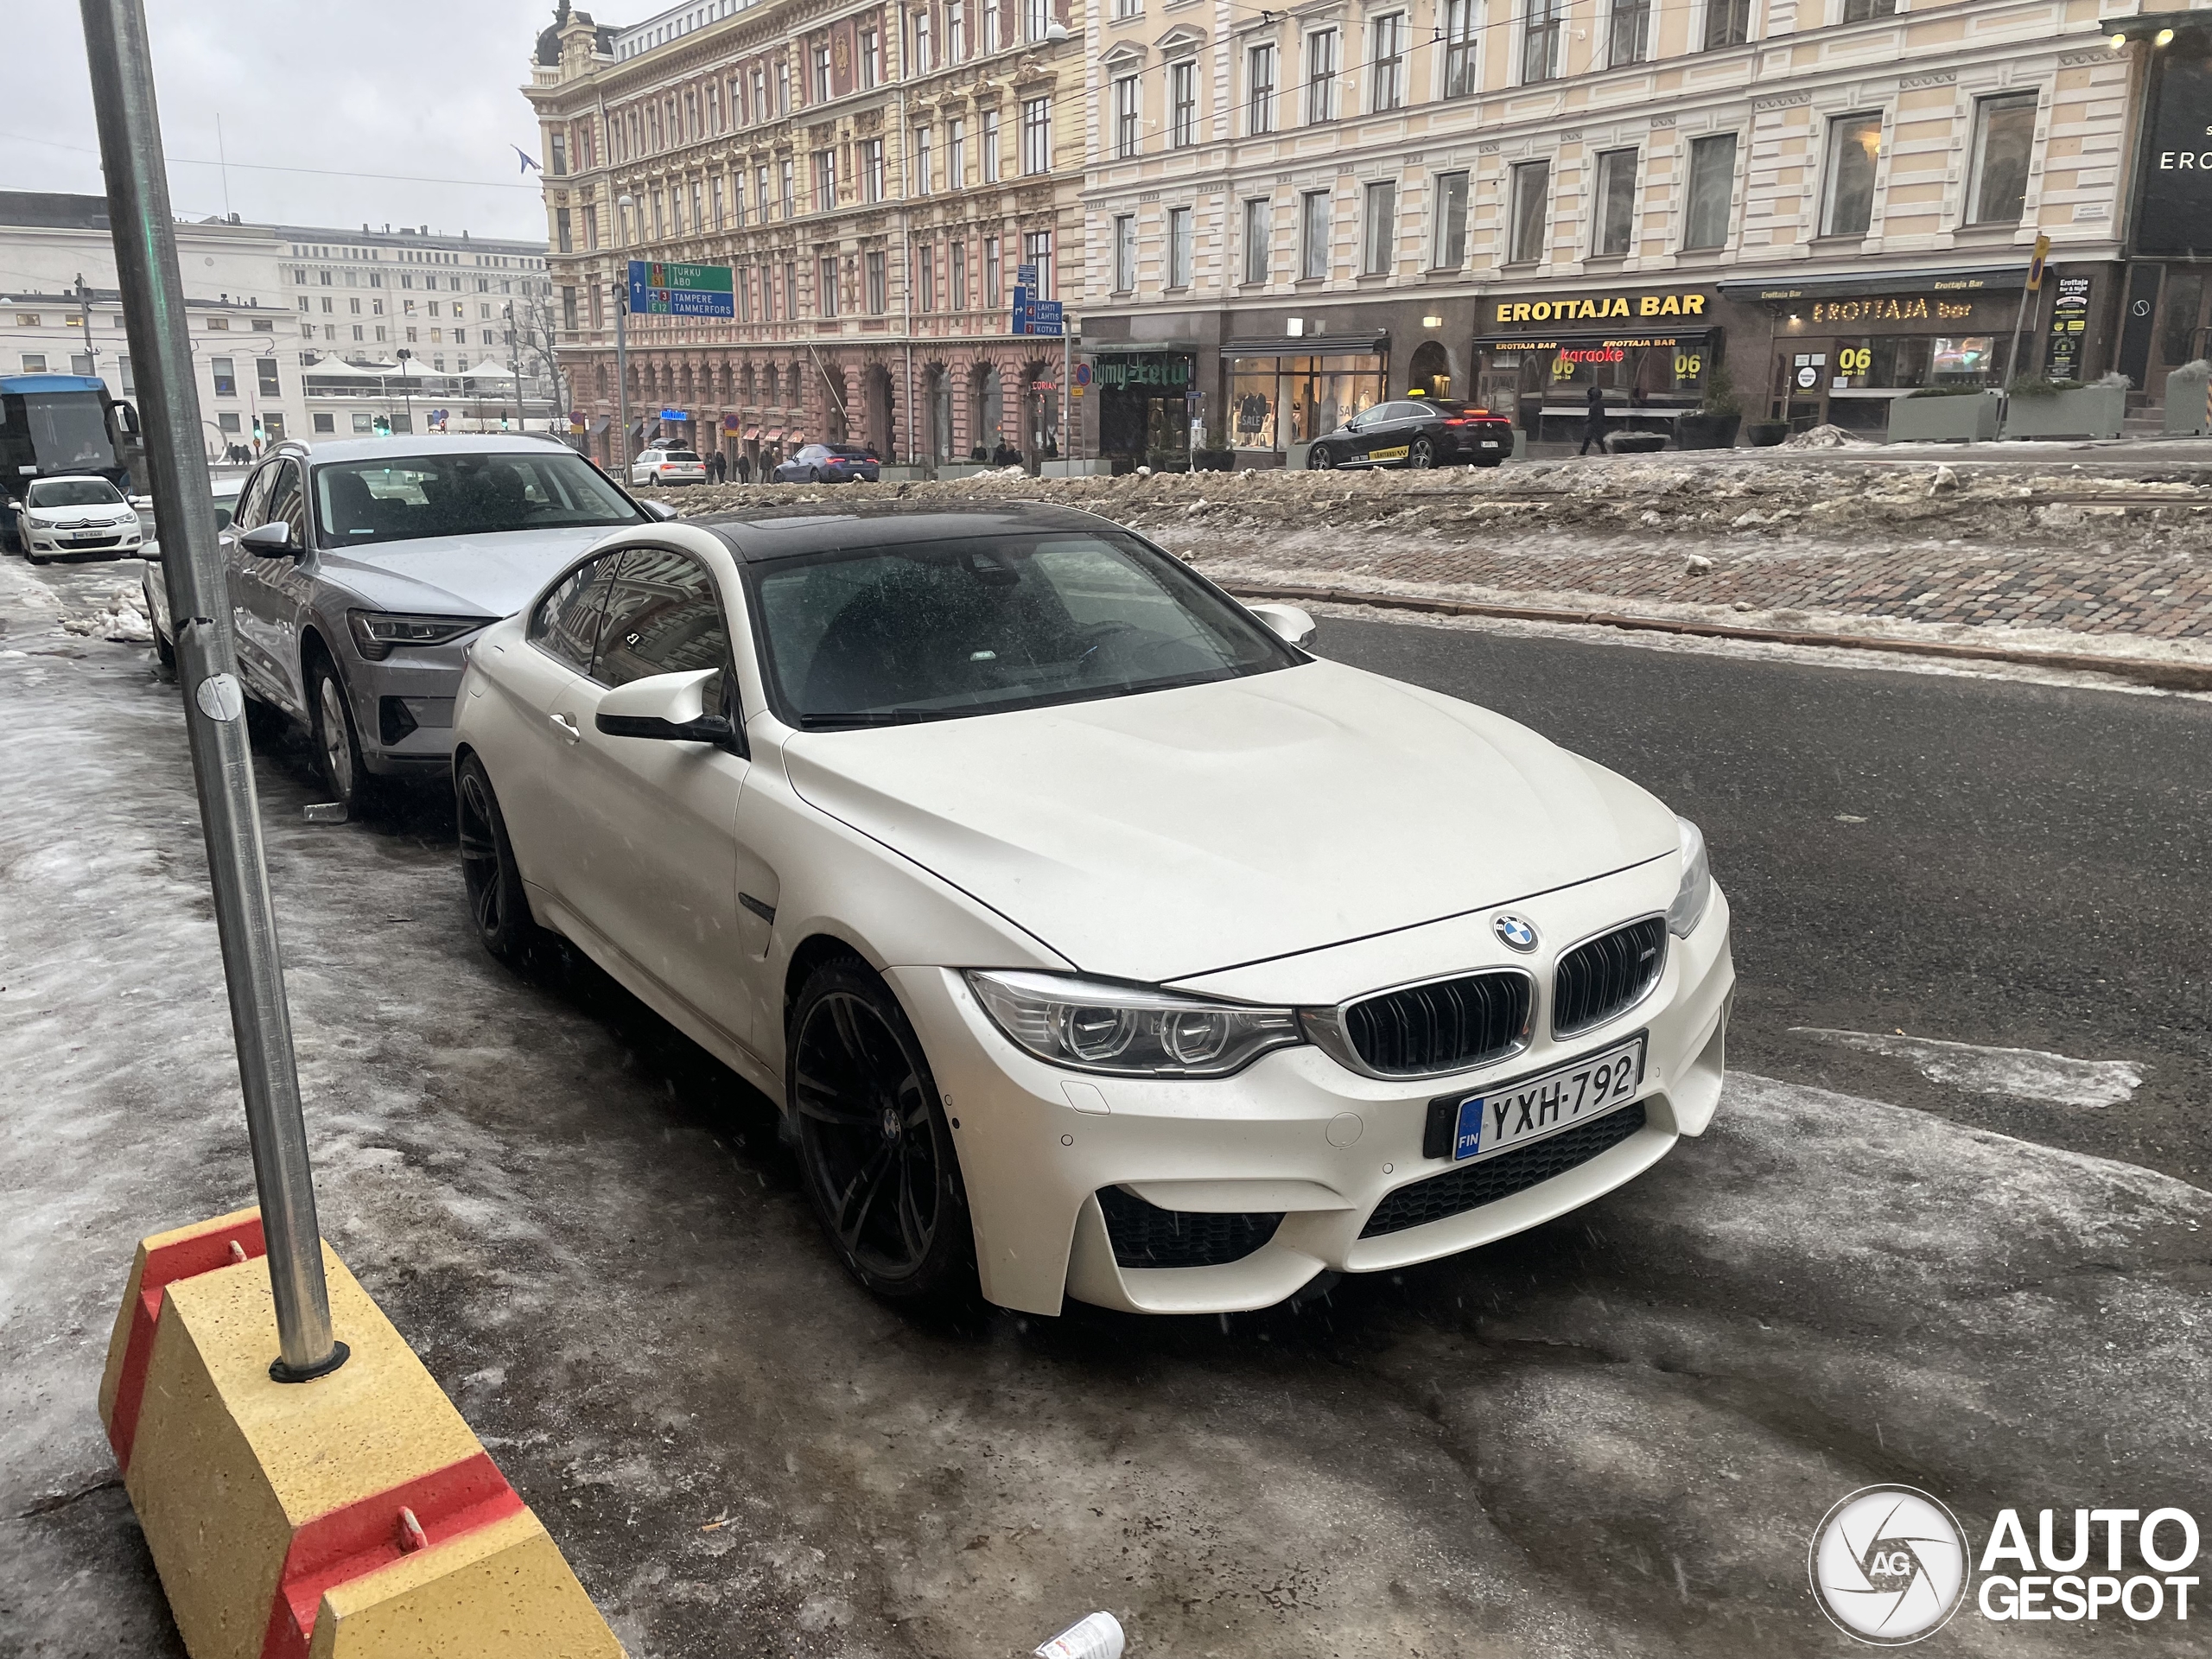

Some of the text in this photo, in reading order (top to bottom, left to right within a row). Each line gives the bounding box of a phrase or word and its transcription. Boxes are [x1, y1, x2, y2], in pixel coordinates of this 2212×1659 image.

[656, 264, 659, 274] 1
[673, 266, 701, 276] TURKU
[654, 276, 663, 285] 51
[673, 274, 690, 286] ÅBO
[1934, 279, 1984, 290] Erottaja Bar
[662, 292, 667, 301] 3
[674, 293, 713, 303] TAMPERE
[1761, 289, 1802, 299] Erottaja Bar
[652, 302, 667, 313] E 12
[675, 303, 731, 315] TAMMERFORS
[1497, 294, 1706, 321] EROTTAJA BAR
[1812, 298, 1929, 322] EROTTAJA
[1037, 312, 1059, 321] LAHTIS
[1560, 346, 1624, 364] karaoke
[1840, 348, 1872, 369] 06
[1552, 358, 1574, 375] 06
[1675, 355, 1701, 374] 06
[1242, 415, 1261, 427] SALE
[1496, 916, 1524, 931] BMW
[1492, 1055, 1631, 1141] YXH-792
[1459, 1132, 1479, 1149] FIN
